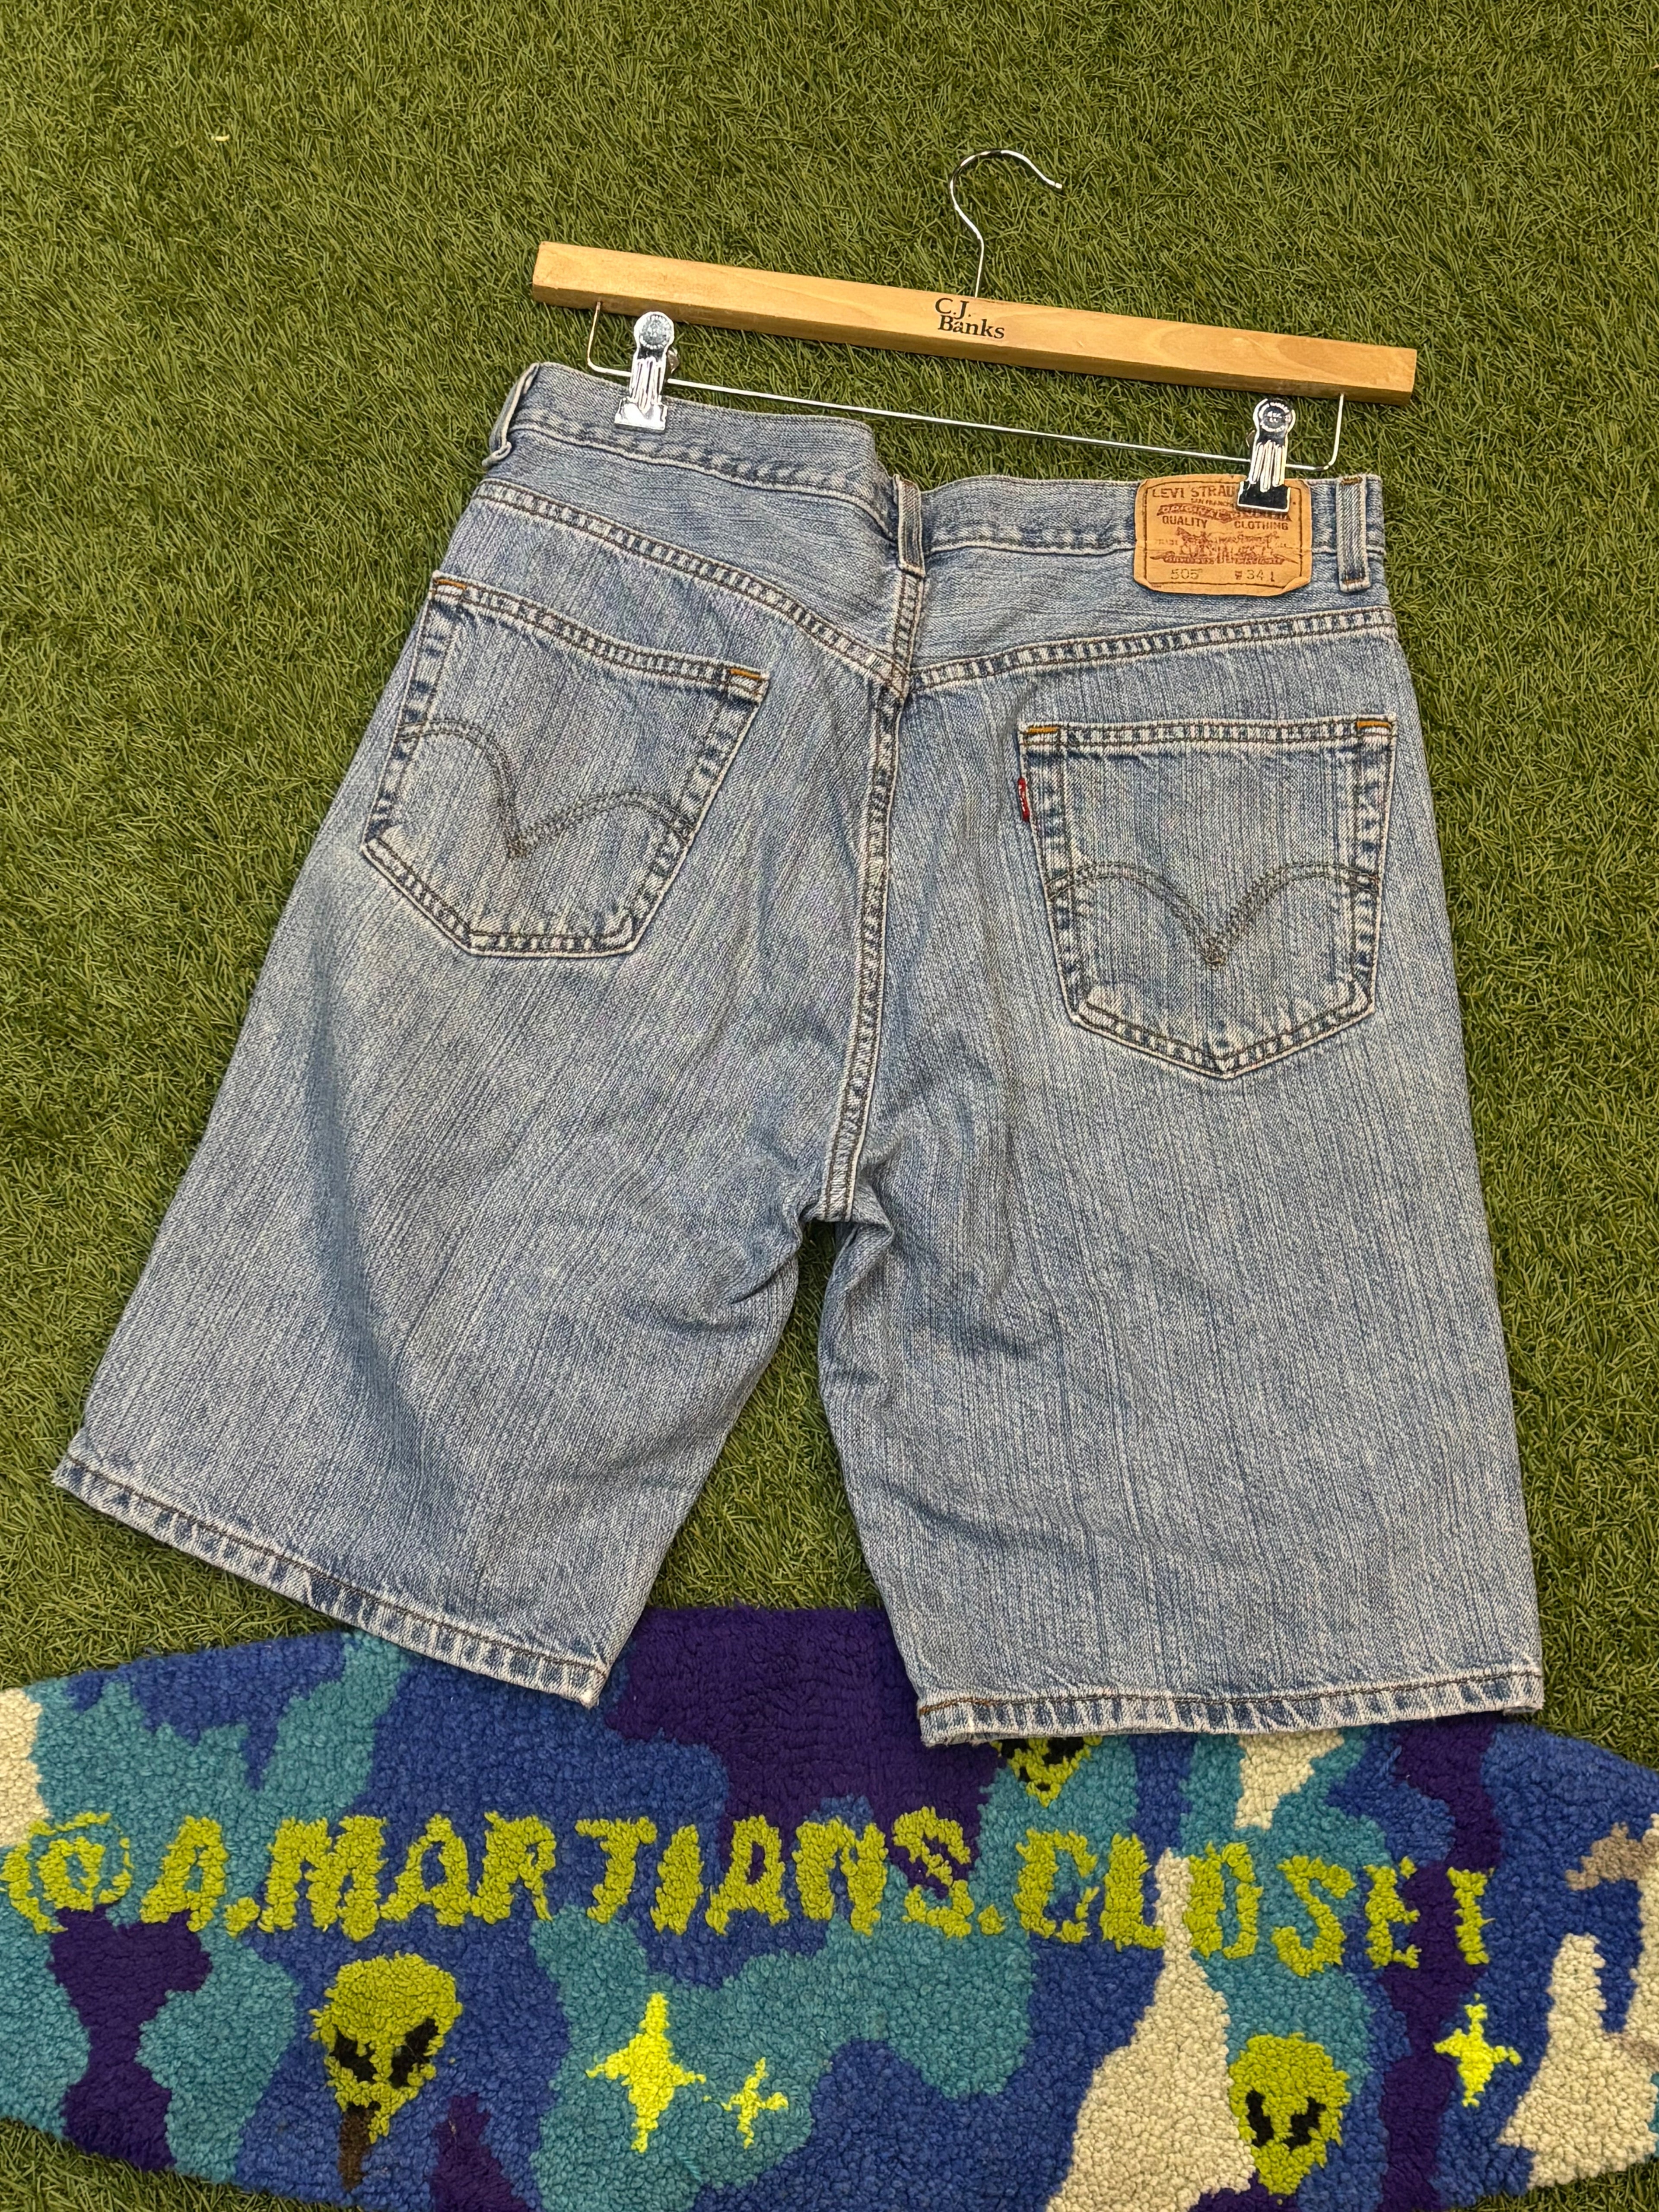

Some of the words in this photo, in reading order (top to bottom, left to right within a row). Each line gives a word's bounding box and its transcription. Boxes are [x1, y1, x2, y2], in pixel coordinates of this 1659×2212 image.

[935, 297, 971, 320] C.J.
[938, 314, 1005, 339] Banks
[1152, 487, 1185, 498] LEVI
[1191, 485, 1236, 497] STRAU
[1162, 515, 1208, 529] QUALITY
[1234, 521, 1289, 531] CLOTHING
[1246, 569, 1264, 581] 34
